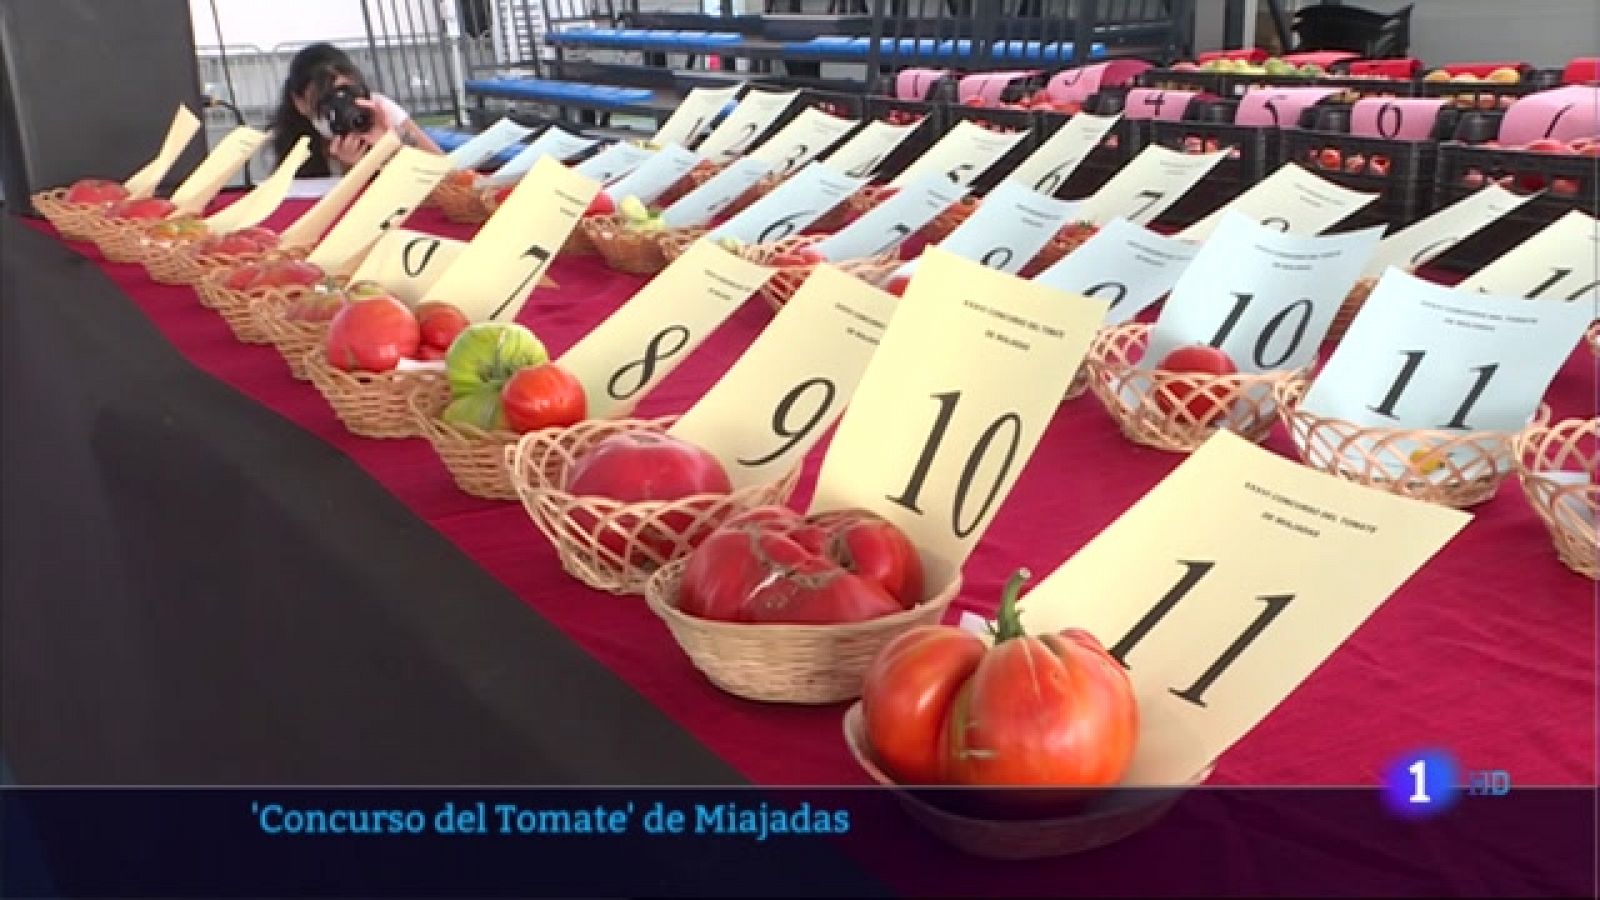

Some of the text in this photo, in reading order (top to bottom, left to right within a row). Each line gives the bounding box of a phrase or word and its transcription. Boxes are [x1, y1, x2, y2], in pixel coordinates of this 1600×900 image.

[1144, 93, 1166, 116] 4
[488, 244, 551, 321] 7
[607, 324, 691, 401] 8
[1206, 290, 1314, 369] 10
[737, 376, 836, 466] 9
[1366, 349, 1500, 430] 11
[884, 388, 1022, 539] 10
[1108, 558, 1297, 708] 11
